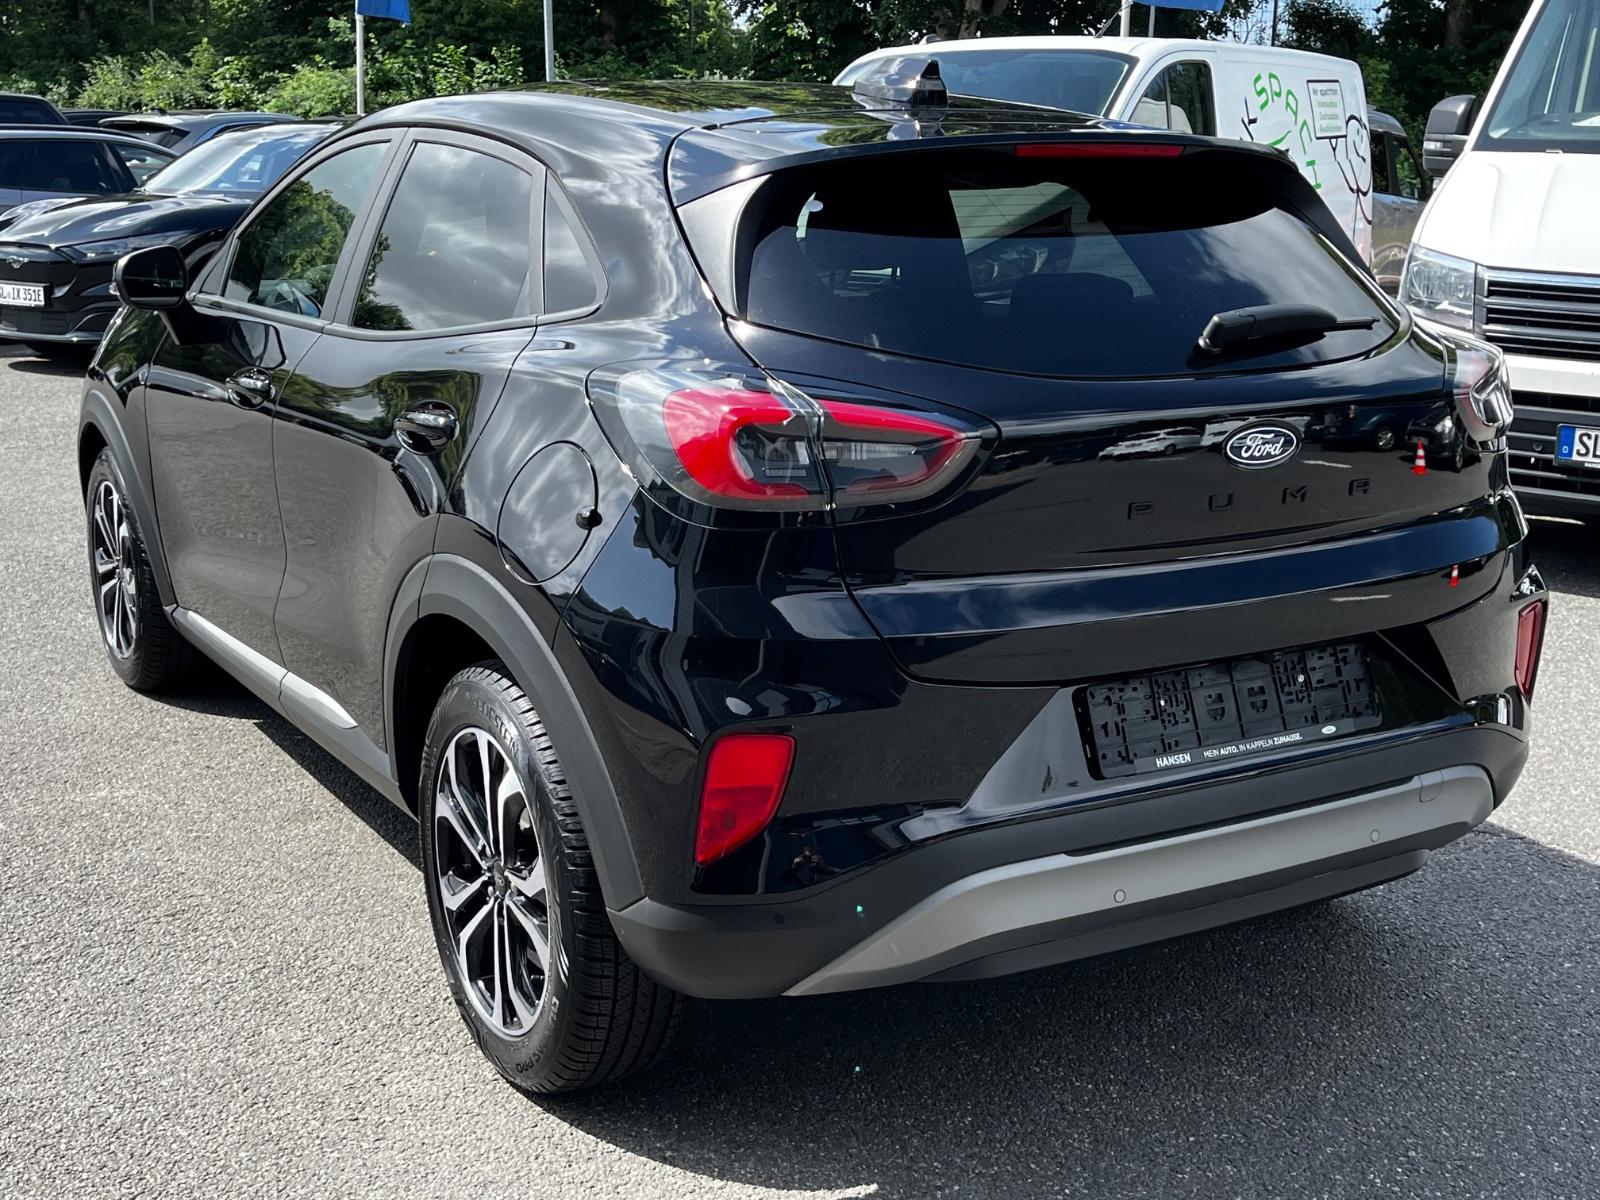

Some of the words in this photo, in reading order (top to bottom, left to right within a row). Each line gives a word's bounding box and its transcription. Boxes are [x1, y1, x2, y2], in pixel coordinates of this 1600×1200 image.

[1240, 433, 1283, 458] Ford
[1127, 478, 1371, 520] PUMA
[1155, 752, 1192, 768] HANSEN
[1203, 748, 1220, 759] MEIN
[1220, 745, 1239, 756] AUTO.
[1239, 743, 1247, 752] IN
[1247, 739, 1274, 751] KAPPELN
